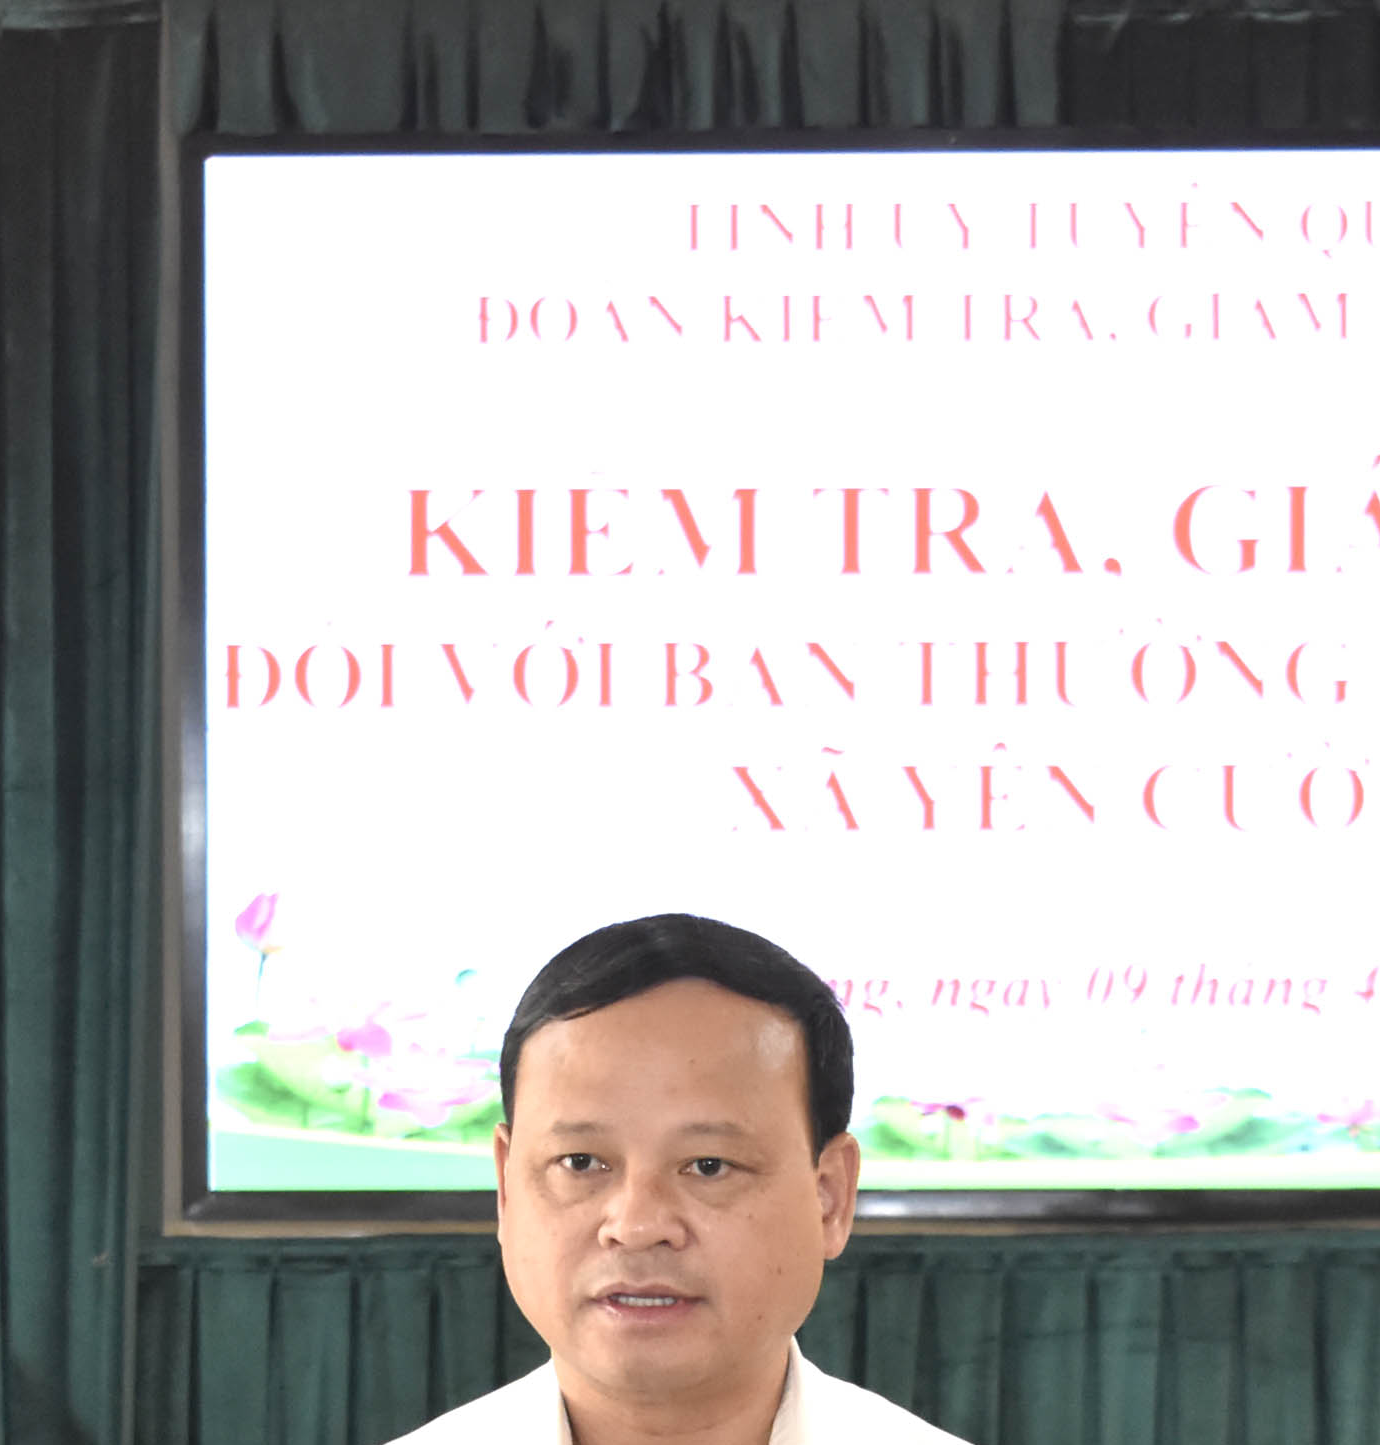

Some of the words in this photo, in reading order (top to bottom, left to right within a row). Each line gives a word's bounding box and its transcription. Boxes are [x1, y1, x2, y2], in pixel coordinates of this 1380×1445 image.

[811, 486, 1123, 578] TRA,
[731, 746, 861, 831] XÃ
[899, 741, 1097, 831] YÊN
